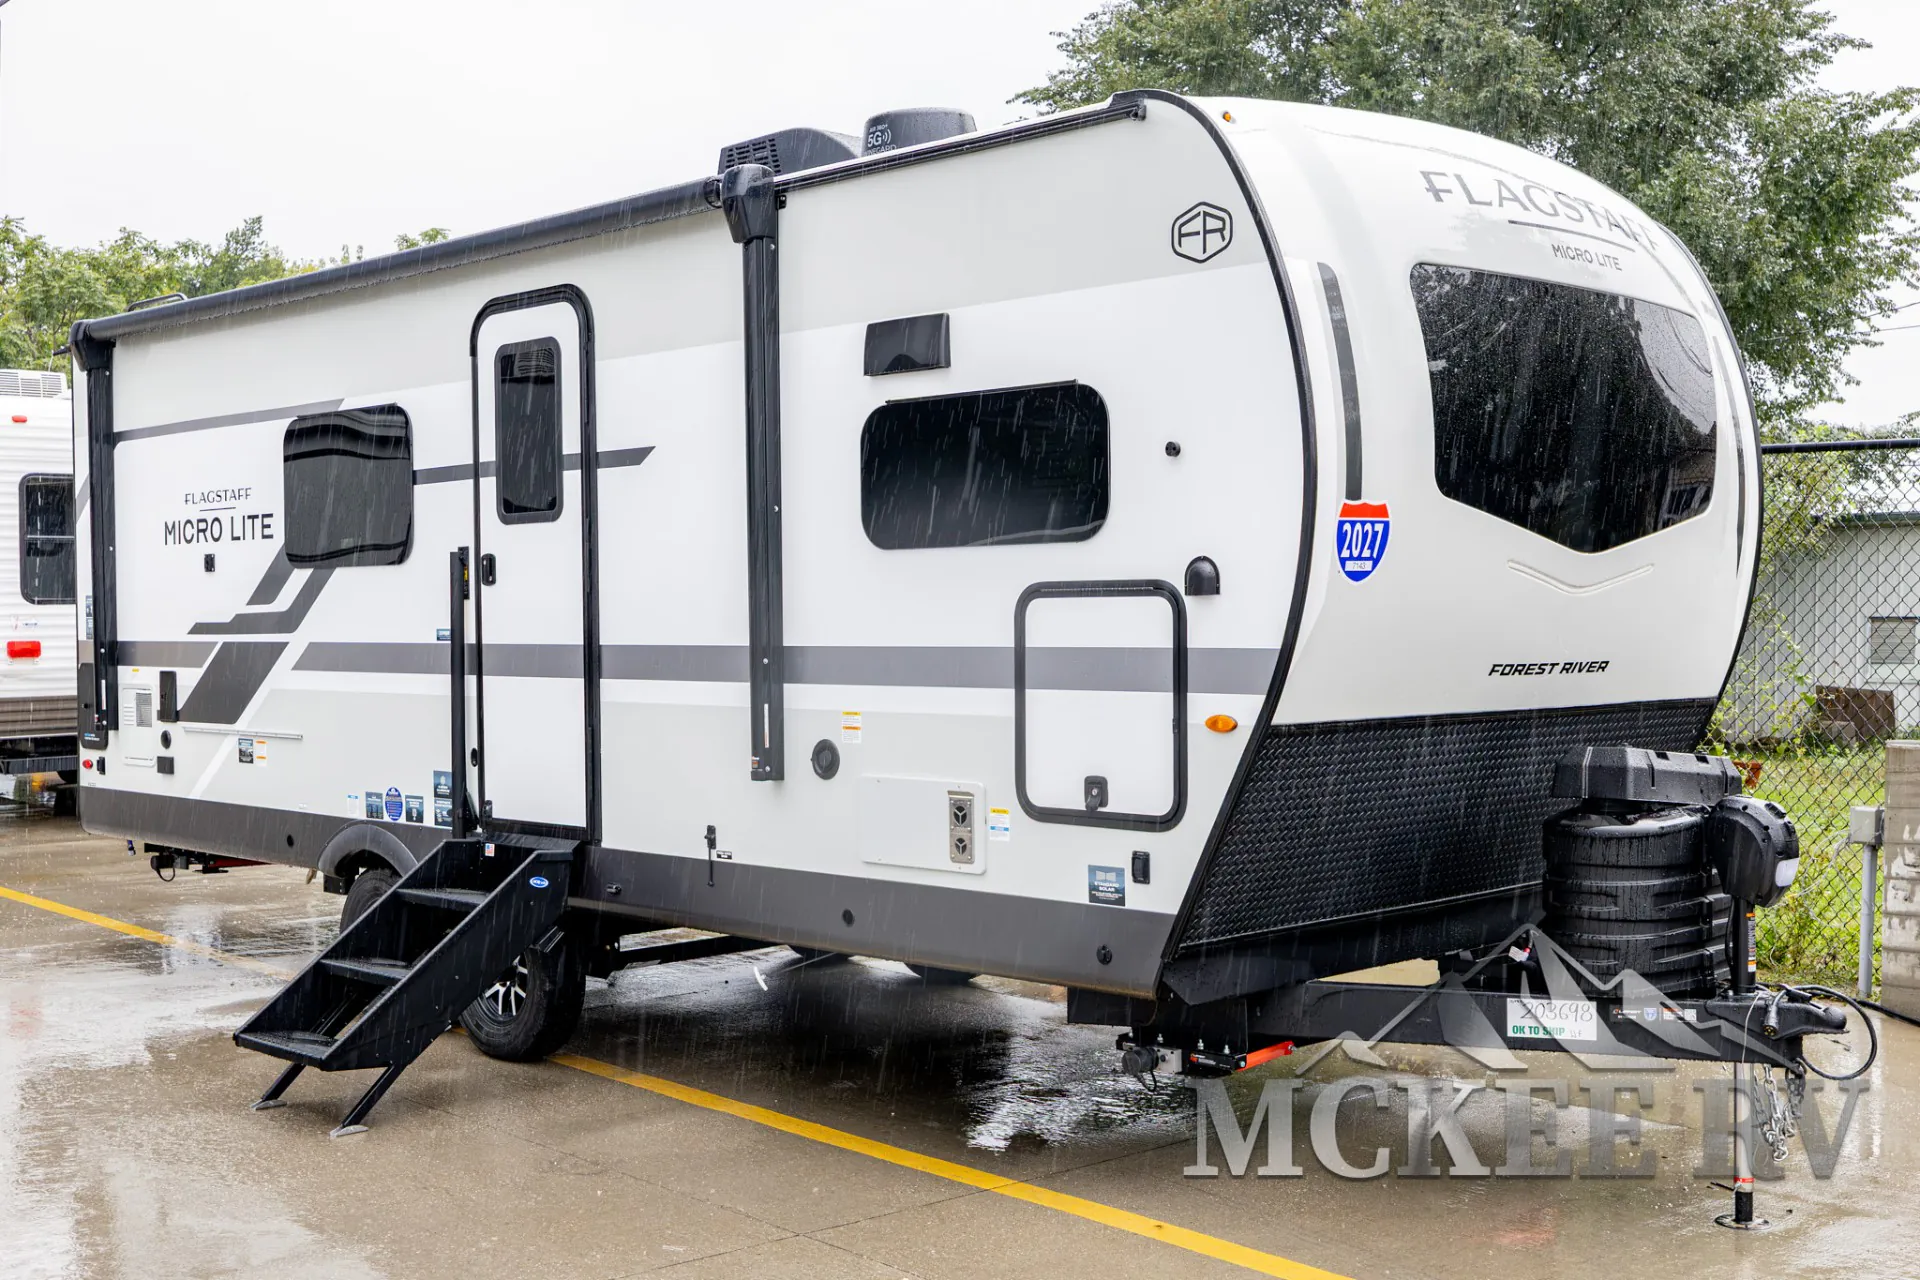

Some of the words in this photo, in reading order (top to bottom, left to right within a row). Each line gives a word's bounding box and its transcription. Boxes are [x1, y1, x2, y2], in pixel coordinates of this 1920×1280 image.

[868, 131, 882, 148] 5G
[1419, 170, 1660, 250] FLAGSTAFF
[1551, 243, 1593, 264] MICRO
[1594, 252, 1623, 271] LITE
[184, 487, 252, 505] FLAGSTAFF
[164, 516, 223, 546] MICRO
[230, 513, 274, 541] LITE
[1340, 522, 1385, 559] 2027
[1488, 662, 1560, 676] FOREST
[1559, 660, 1610, 675] RIVER
[1520, 1002, 1593, 1022] 203698
[1512, 1025, 1526, 1035] OK
[1528, 1025, 1540, 1036] TO
[1542, 1026, 1565, 1037] SHIP
